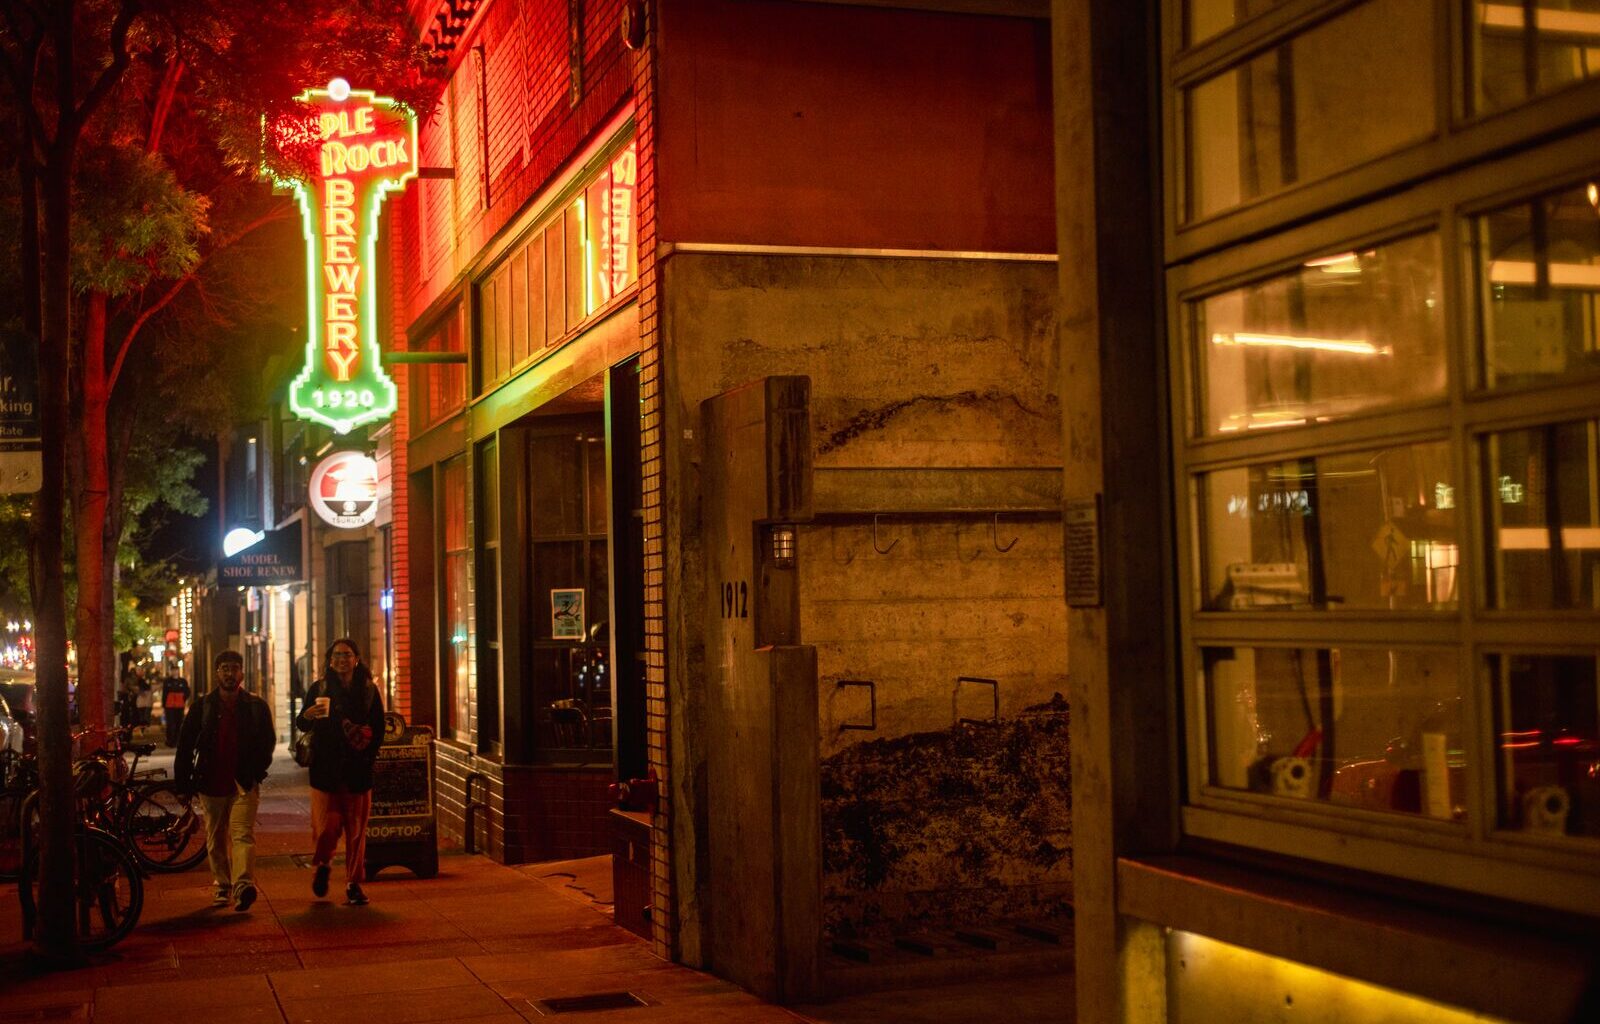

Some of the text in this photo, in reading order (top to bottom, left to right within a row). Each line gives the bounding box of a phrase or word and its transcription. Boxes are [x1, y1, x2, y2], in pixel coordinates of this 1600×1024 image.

[321, 138, 409, 177] ROCK
[323, 179, 360, 382] BREWERY
[312, 390, 375, 408] 1920
[223, 566, 296, 577] SHOE RENEW
[241, 554, 281, 564] MODEL
[721, 581, 748, 619] 1912
